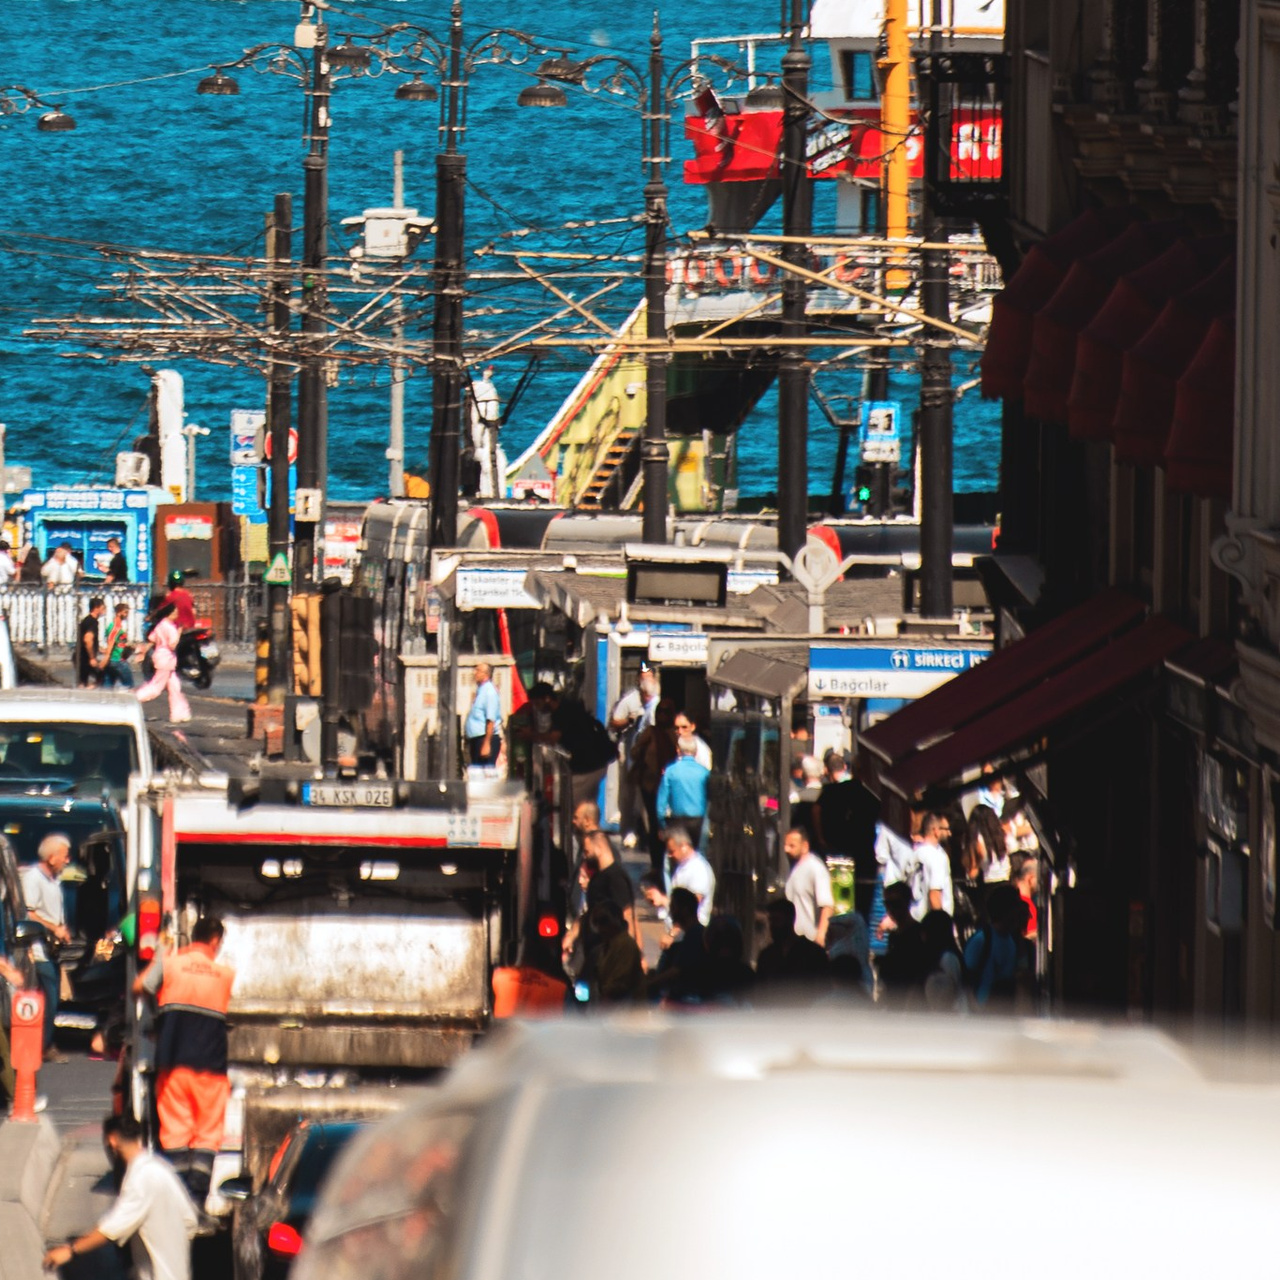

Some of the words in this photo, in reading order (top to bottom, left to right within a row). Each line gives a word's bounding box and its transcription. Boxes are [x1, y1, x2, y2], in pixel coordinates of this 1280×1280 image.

[914, 651, 965, 669] SİRKECİ
[830, 679, 889, 695] Bağcılar
[311, 789, 326, 804] 34
[334, 790, 357, 805] KSK
[365, 790, 390, 805] 026
